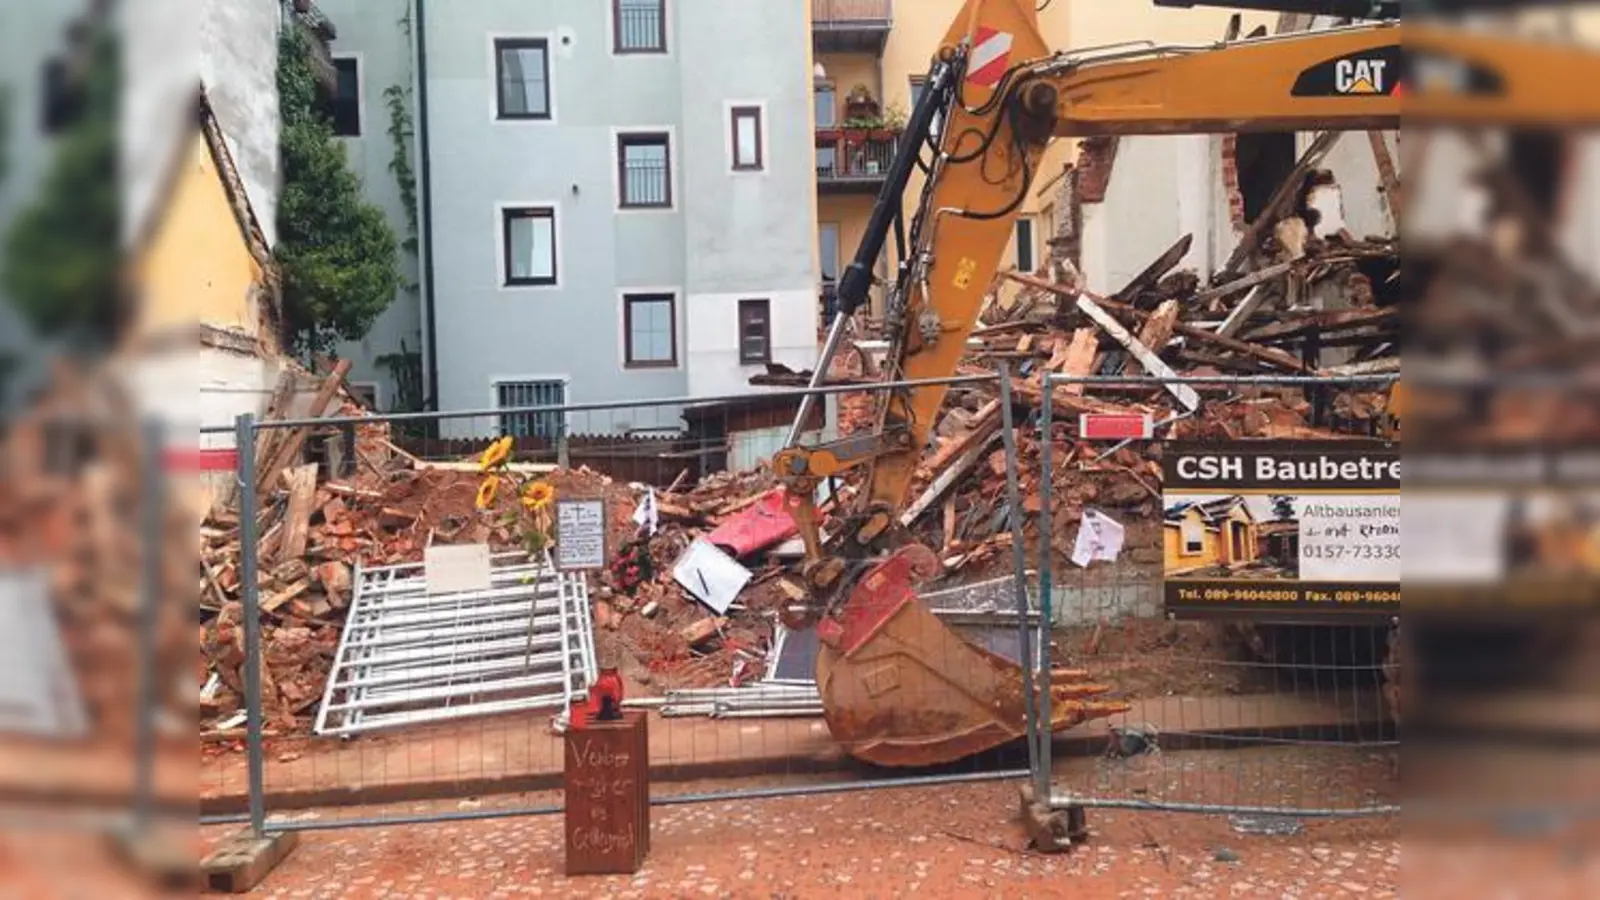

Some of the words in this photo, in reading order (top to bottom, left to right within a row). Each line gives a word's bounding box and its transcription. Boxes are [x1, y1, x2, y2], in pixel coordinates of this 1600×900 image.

[1335, 59, 1387, 93] CAT
[1176, 456, 1243, 480] CSH
[1255, 456, 1400, 481] Baubetre
[1178, 589, 1201, 600] Tel.
[1305, 590, 1332, 601] Fax.
